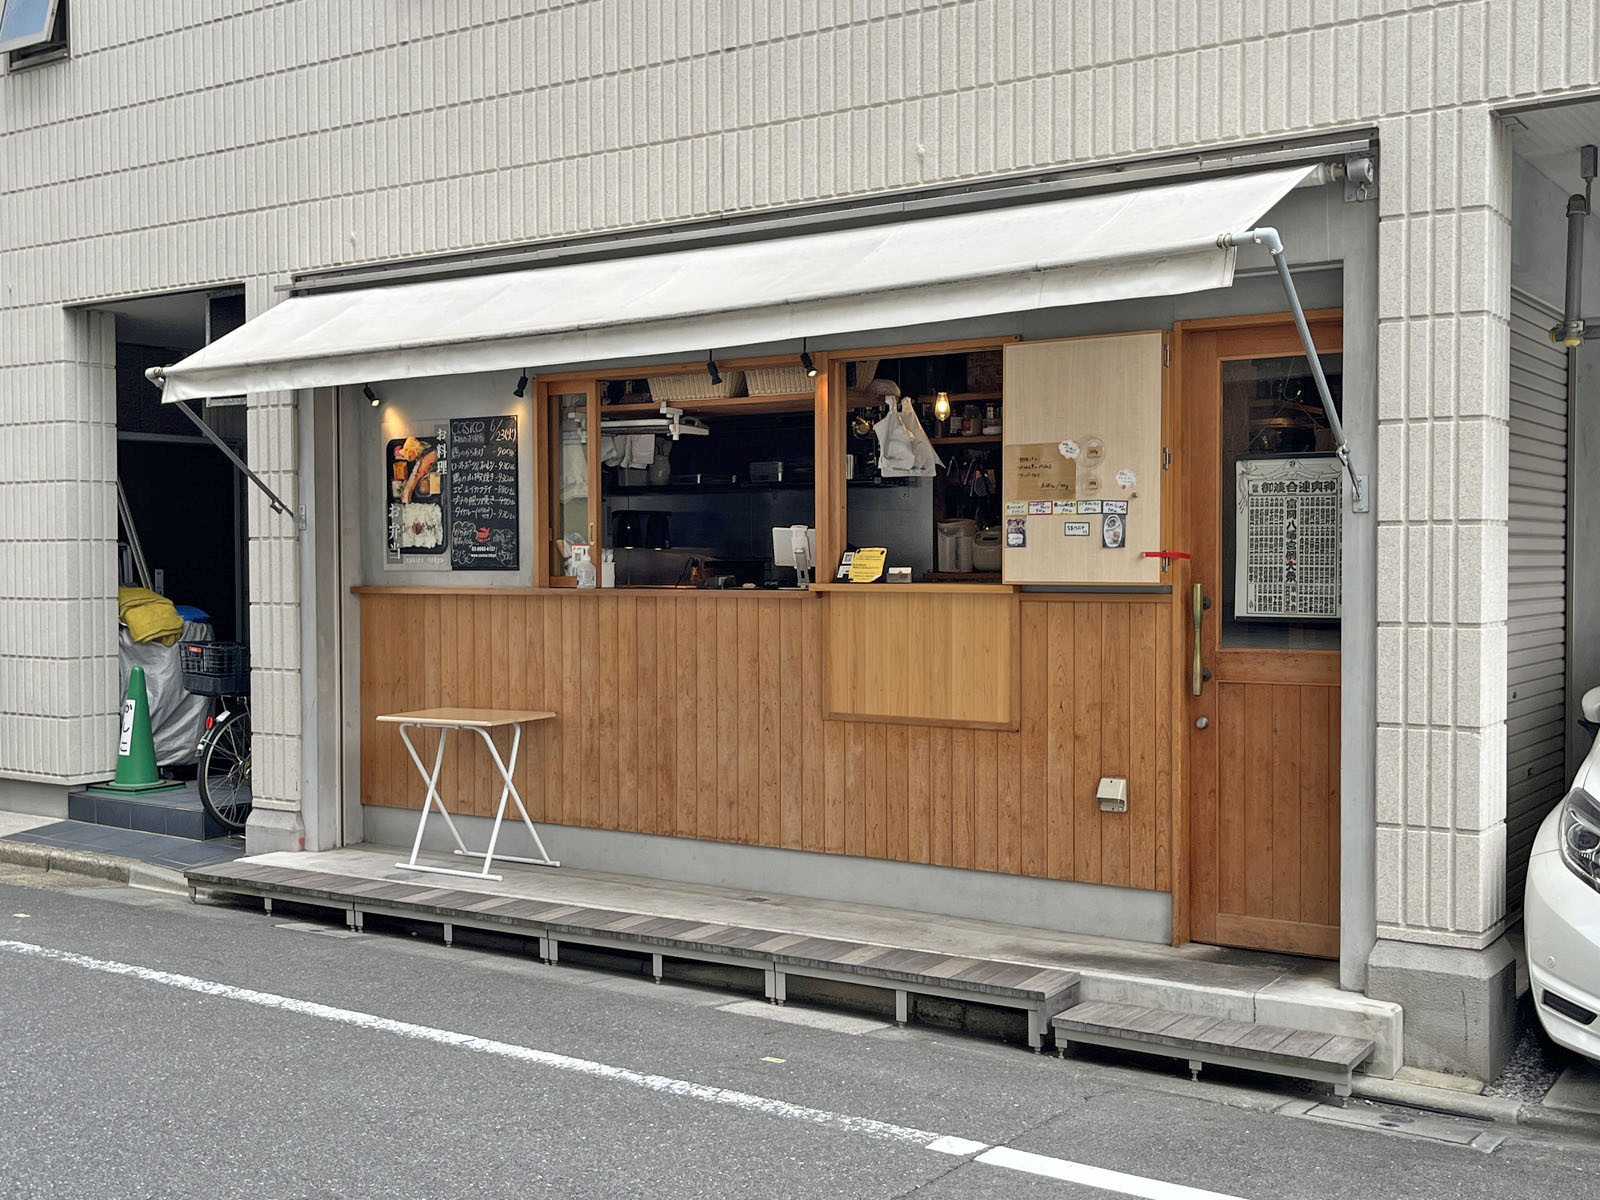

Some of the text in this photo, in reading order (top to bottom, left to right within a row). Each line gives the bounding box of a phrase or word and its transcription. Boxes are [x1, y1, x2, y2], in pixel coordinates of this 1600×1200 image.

[436, 428, 448, 475] お料理
[388, 503, 401, 560] お弁当
